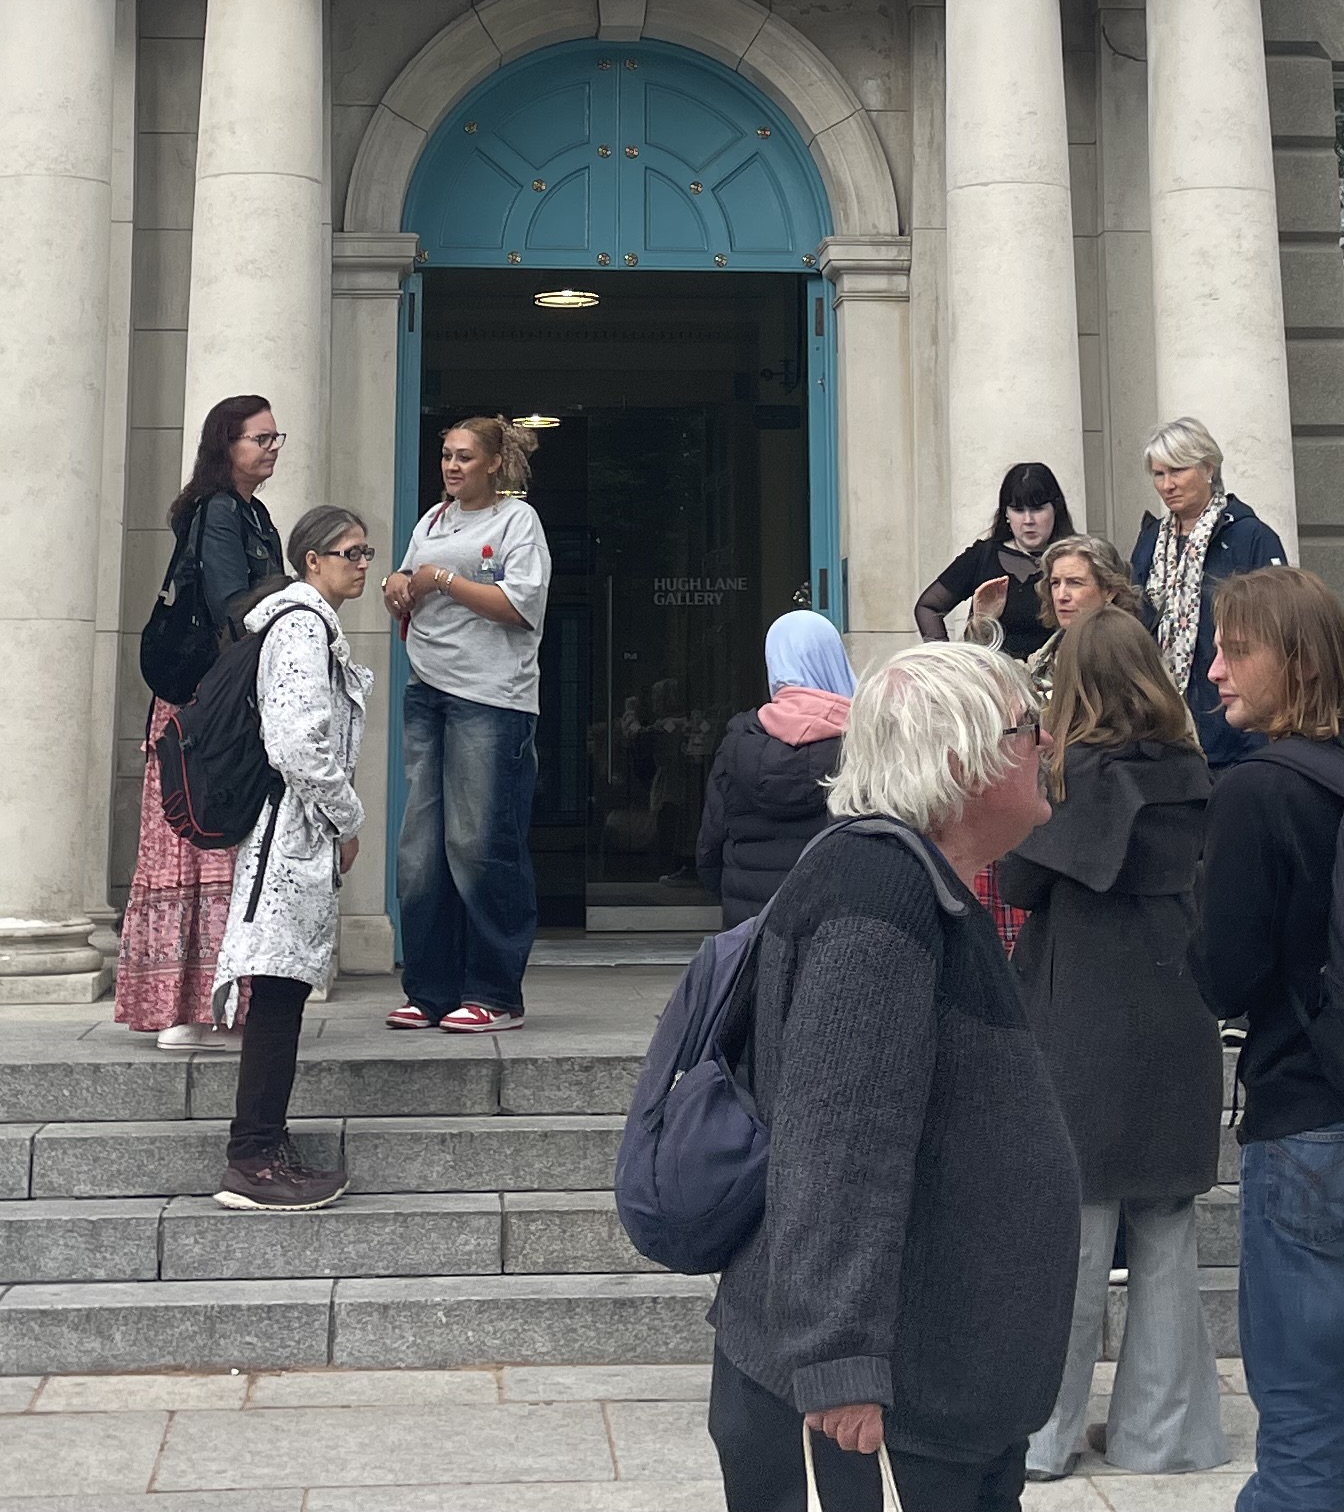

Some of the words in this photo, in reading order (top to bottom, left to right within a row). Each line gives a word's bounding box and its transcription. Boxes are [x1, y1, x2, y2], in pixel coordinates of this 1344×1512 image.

[653, 577, 701, 591] HUGH
[705, 576, 748, 591] LANE
[653, 591, 724, 606] GALLERY
